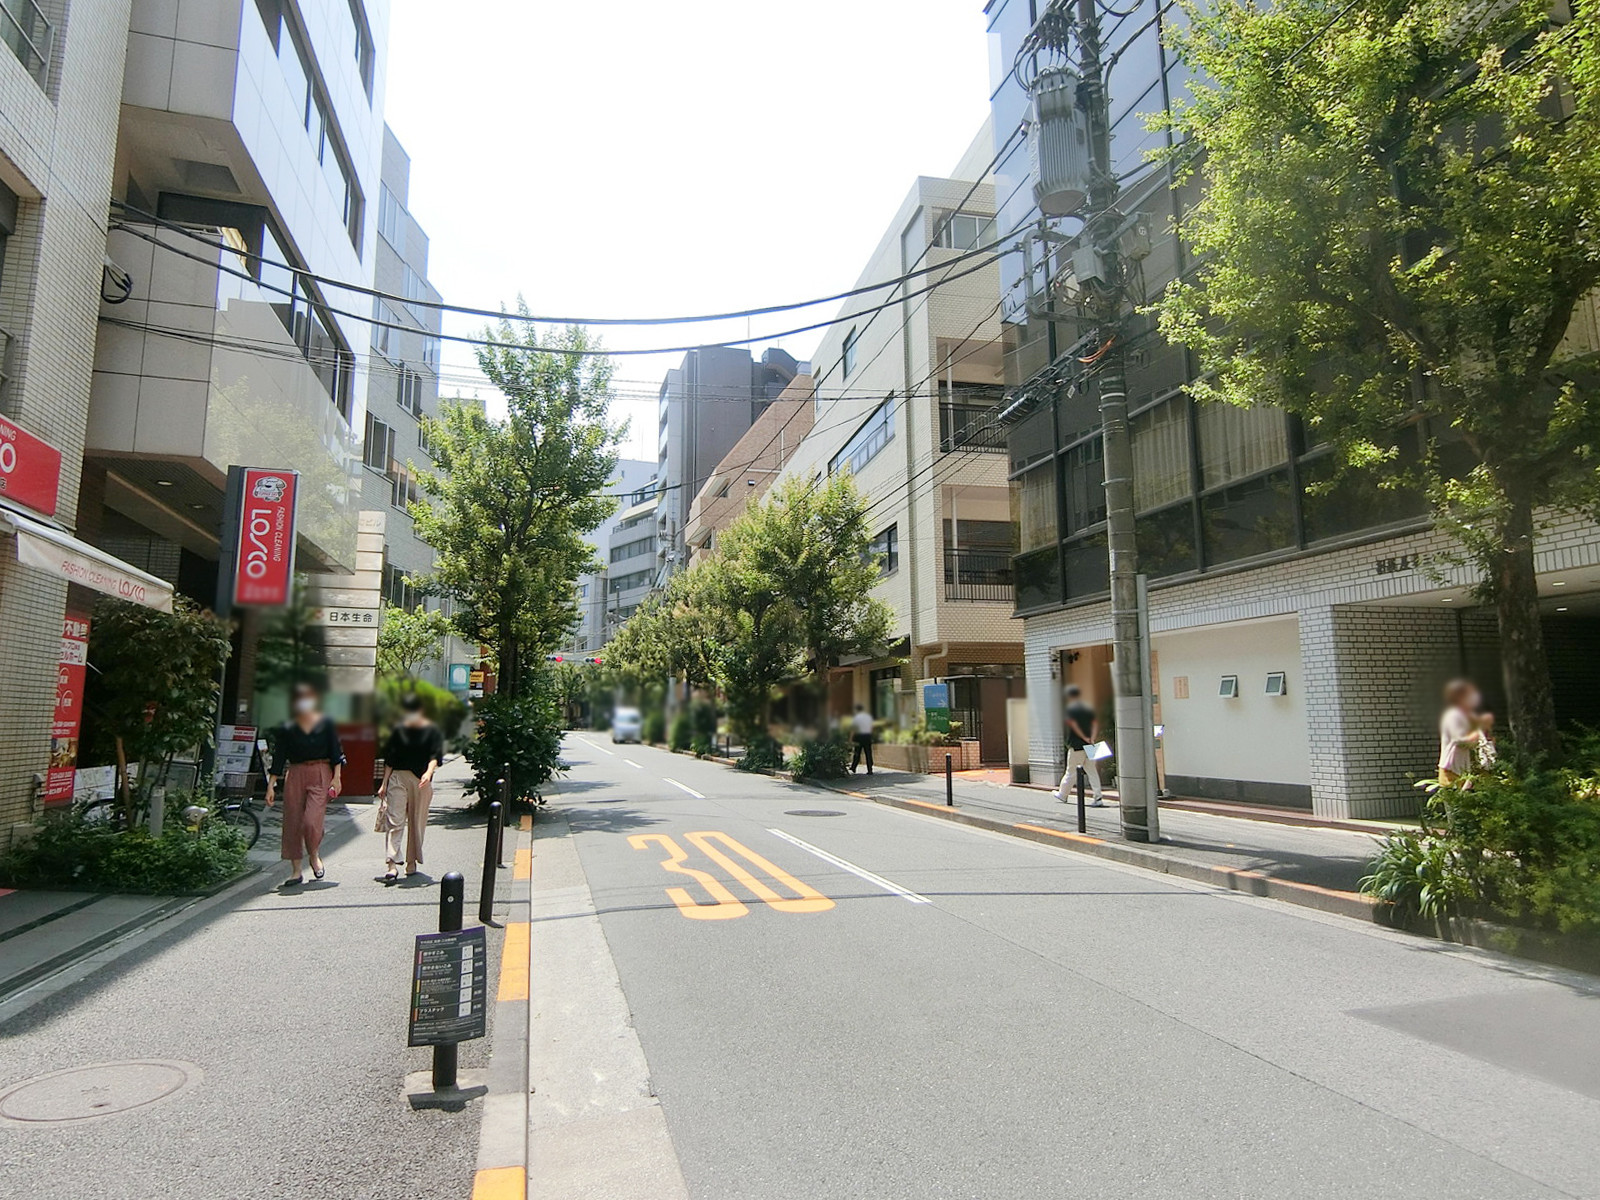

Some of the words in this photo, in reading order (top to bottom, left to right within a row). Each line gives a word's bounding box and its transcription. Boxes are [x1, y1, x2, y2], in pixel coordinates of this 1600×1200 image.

[275, 506, 285, 531] FASHION
[246, 509, 272, 579] LOSCO
[273, 531, 284, 562] CLEANING
[61, 561, 88, 578] FASHION
[89, 571, 117, 588] CLEANING
[329, 611, 373, 623] 日本生命
[626, 830, 837, 920] 30
